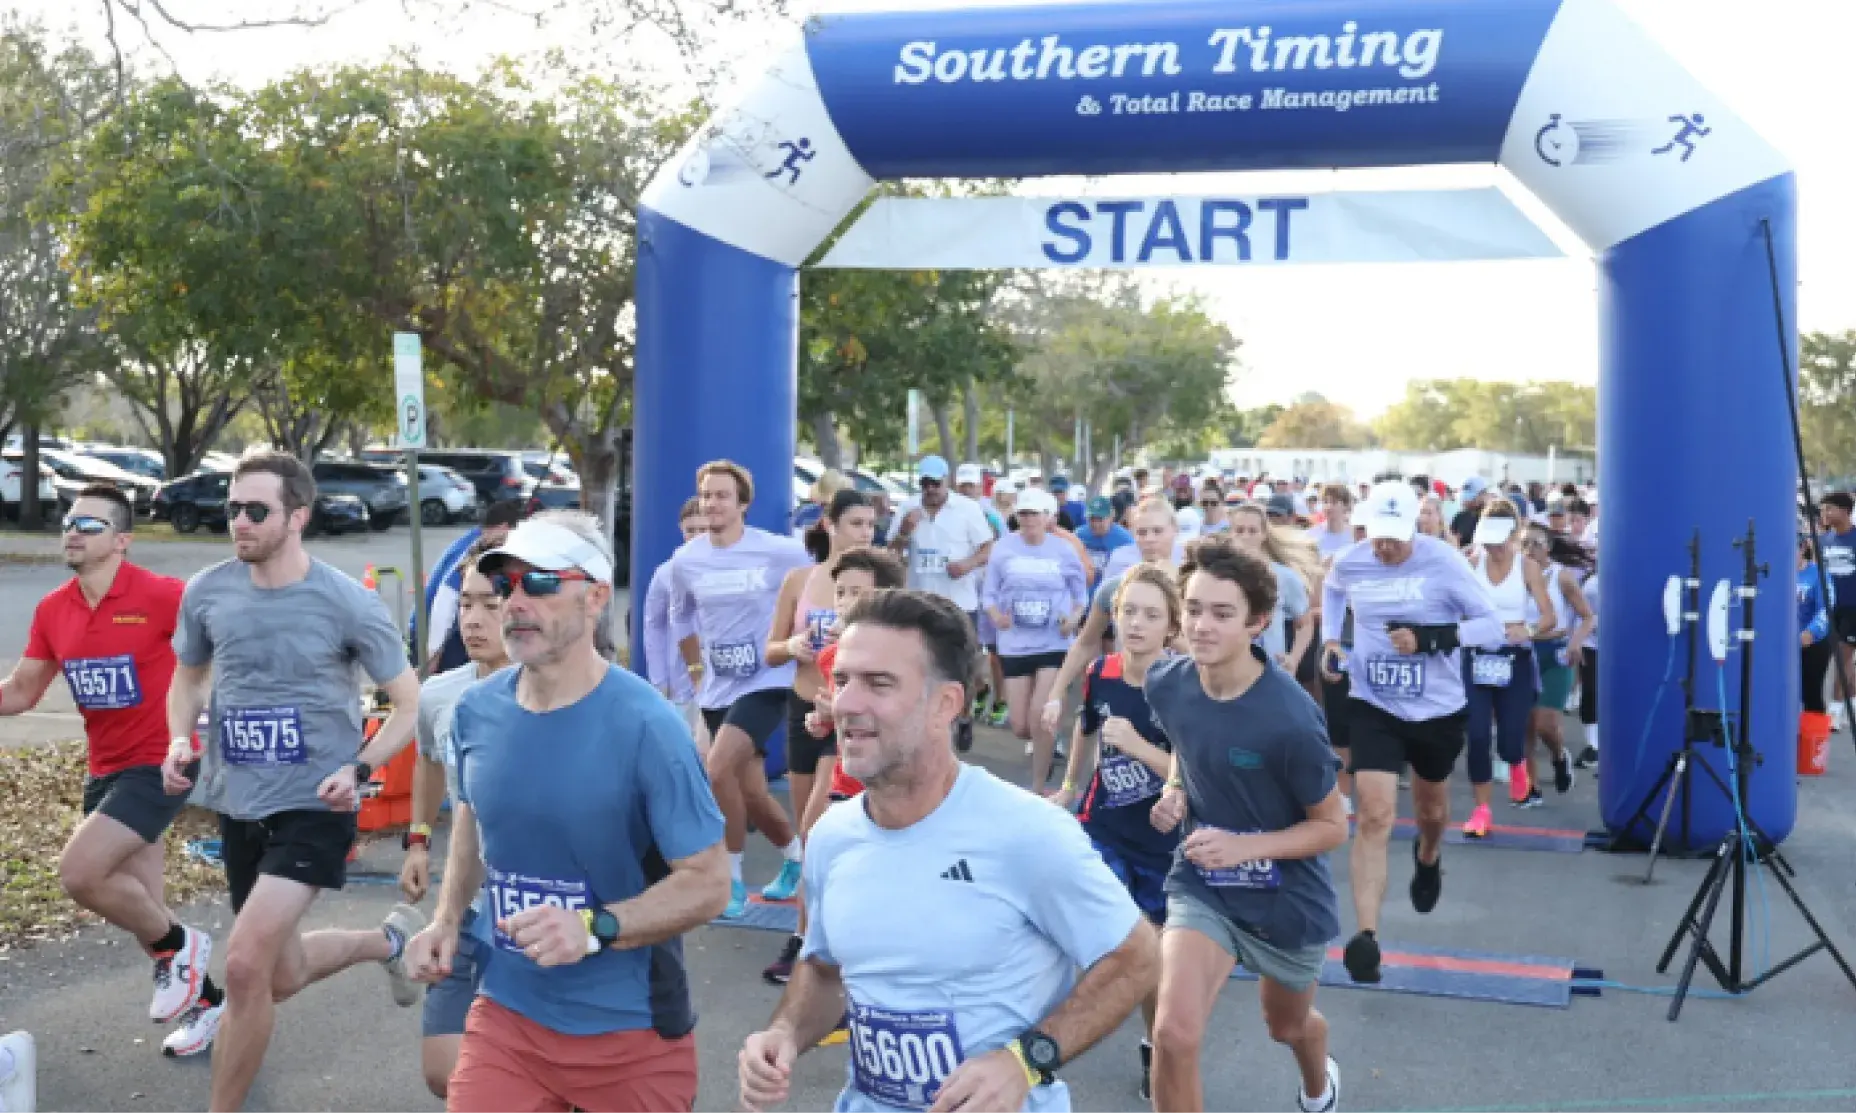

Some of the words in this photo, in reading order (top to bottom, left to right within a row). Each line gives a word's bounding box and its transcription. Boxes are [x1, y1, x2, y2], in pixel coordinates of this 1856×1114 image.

[893, 34, 1182, 84] Southern
[1207, 20, 1444, 79] Timing
[1075, 94, 1102, 116] &
[1109, 89, 1181, 115] Total
[1186, 91, 1253, 112] Race
[1260, 81, 1440, 112] Management
[1041, 198, 1309, 264] START
[68, 665, 135, 697] 15571
[1370, 661, 1421, 686] 15751
[223, 718, 300, 751] 15575
[849, 1018, 957, 1084] 15600
